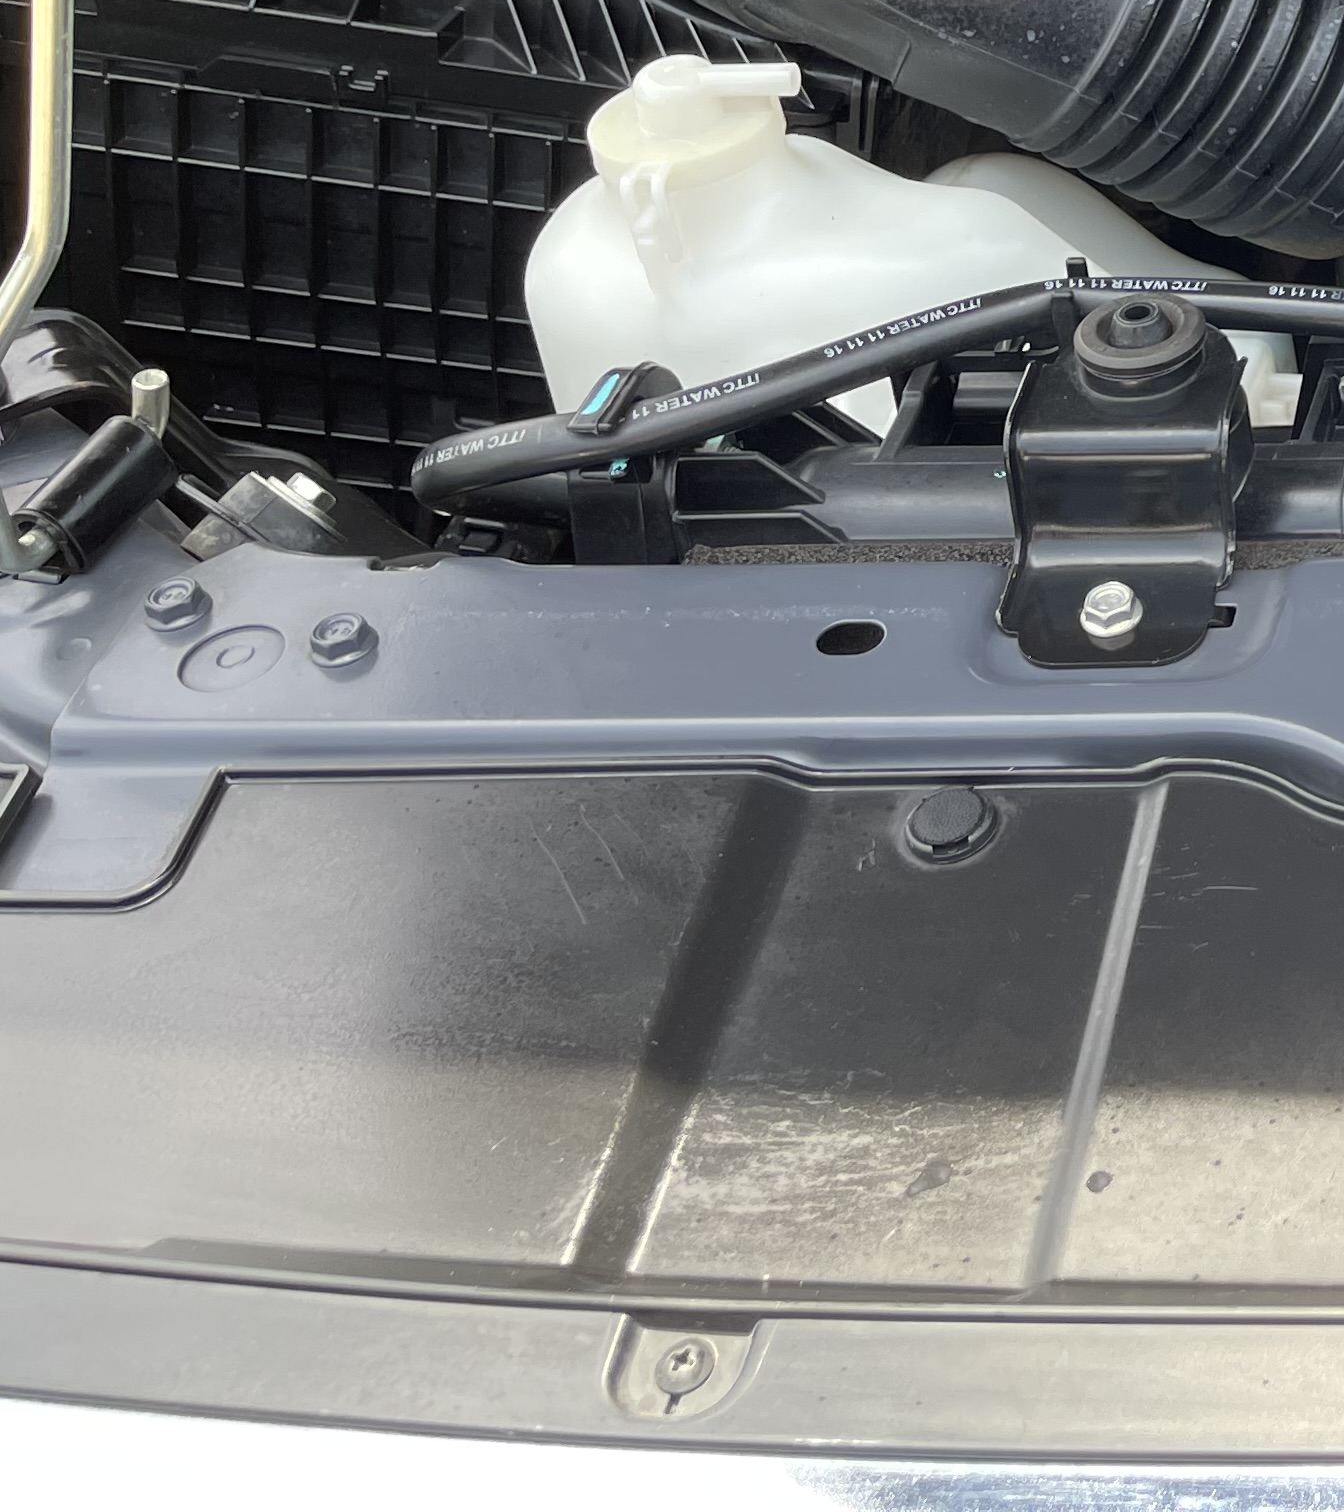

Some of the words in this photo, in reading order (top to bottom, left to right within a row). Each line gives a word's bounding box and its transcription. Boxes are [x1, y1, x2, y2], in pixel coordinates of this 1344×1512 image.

[1044, 279, 1063, 290] 16
[1069, 278, 1085, 289] 11
[1090, 278, 1107, 289] 11
[1111, 279, 1168, 291] WATER
[1269, 286, 1285, 296] 16
[1290, 287, 1306, 297] 11
[1311, 288, 1327, 299] 11
[887, 309, 946, 335] WATER
[868, 330, 885, 342] 11
[847, 337, 864, 349] 11
[823, 345, 843, 358] 16
[654, 387, 721, 413] WATER
[436, 439, 484, 463] WATER
